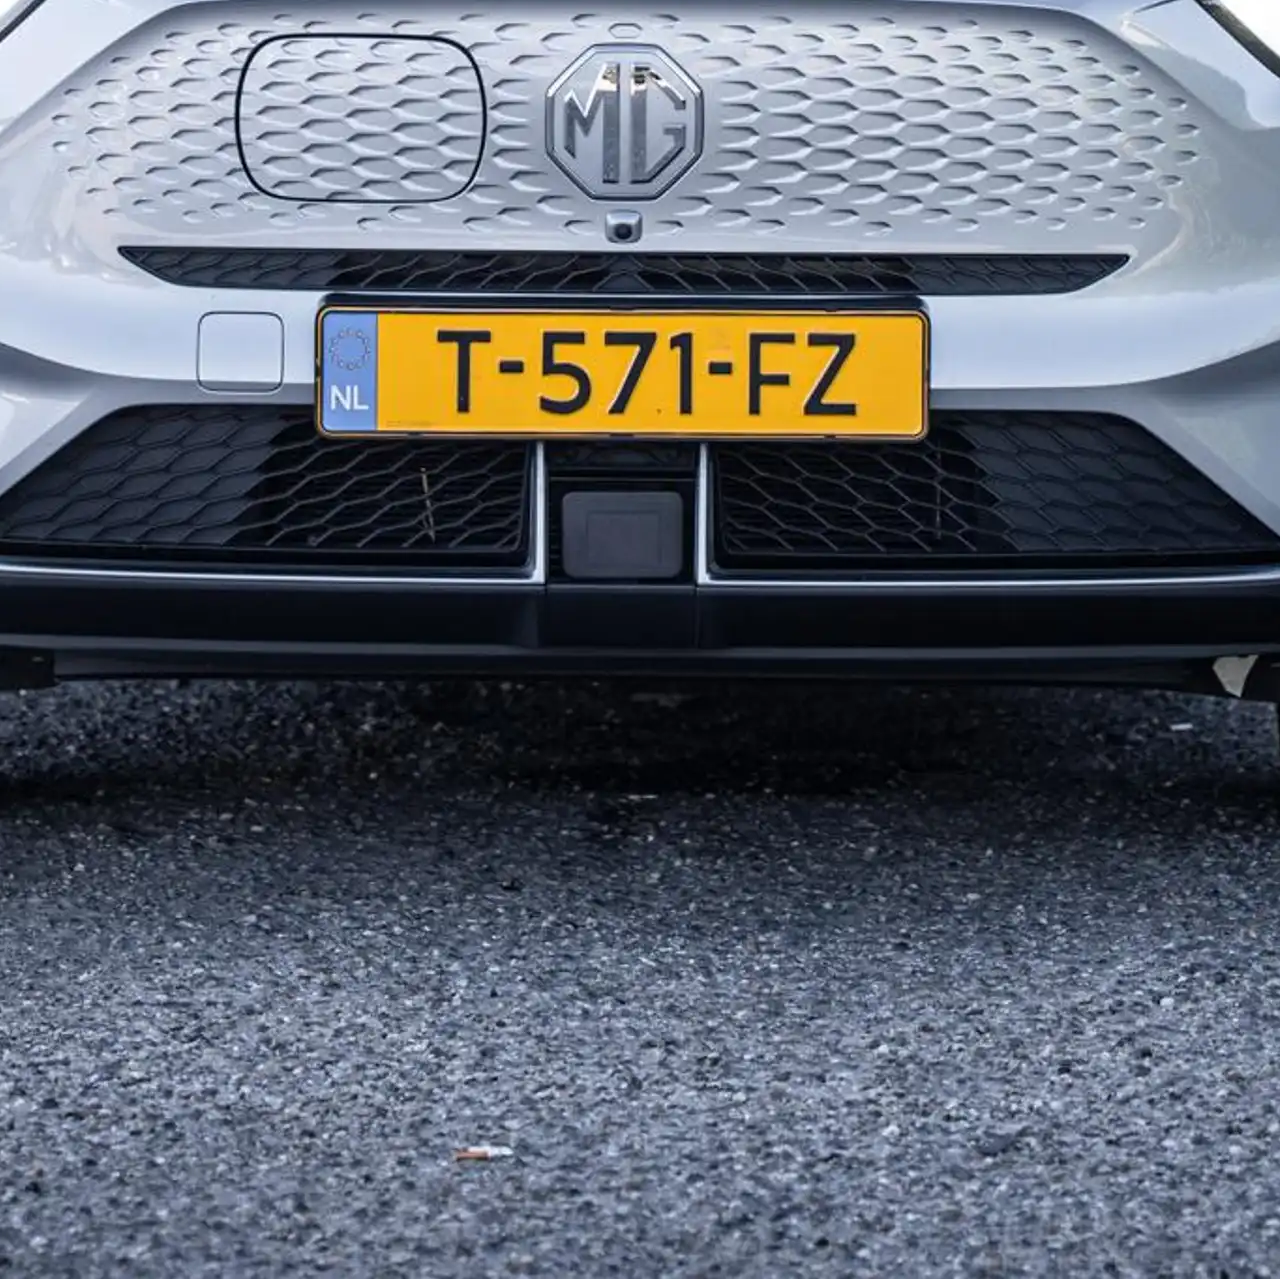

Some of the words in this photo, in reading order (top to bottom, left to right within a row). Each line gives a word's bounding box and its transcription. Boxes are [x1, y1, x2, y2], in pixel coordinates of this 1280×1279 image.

[564, 62, 687, 184] MG
[330, 385, 369, 411] NL
[437, 330, 857, 415] T-571-FZ
